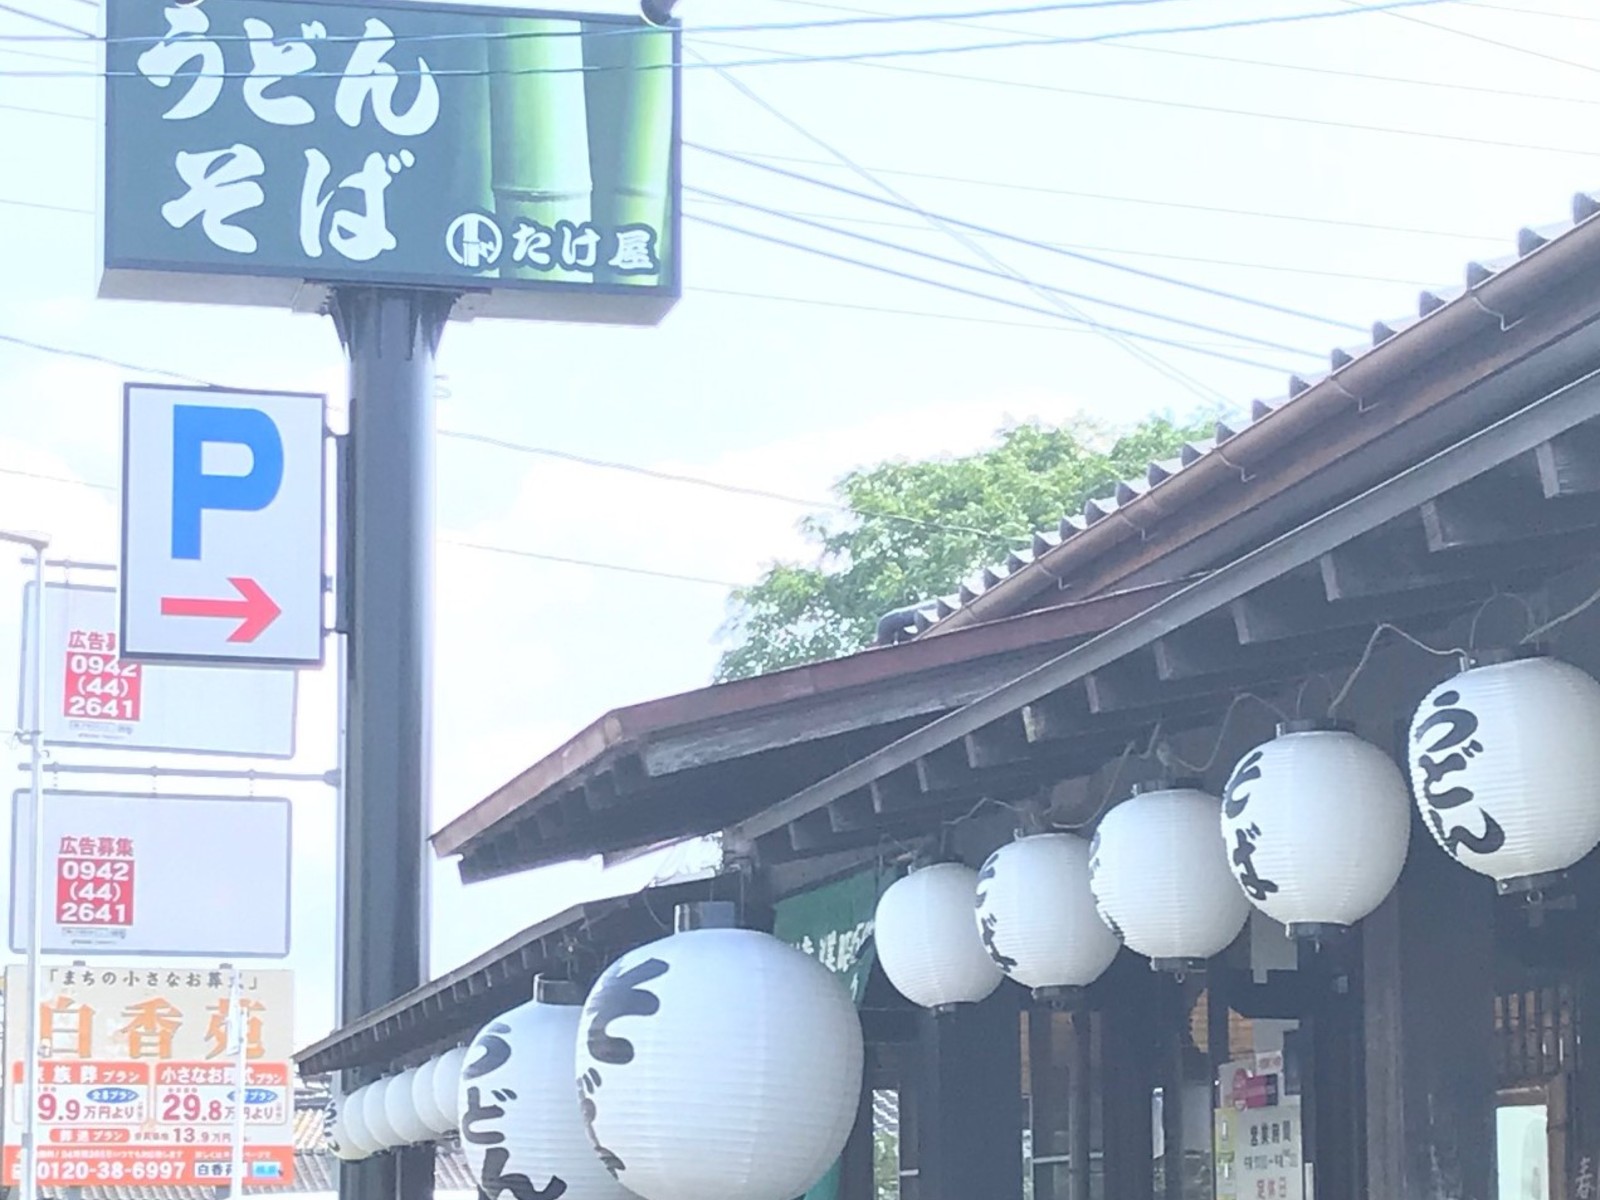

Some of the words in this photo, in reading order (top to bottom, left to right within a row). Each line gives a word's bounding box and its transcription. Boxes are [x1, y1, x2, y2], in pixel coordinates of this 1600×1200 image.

[137, 5, 441, 137] うどん
[161, 142, 416, 262] そば
[511, 222, 658, 270] たけ屋
[171, 404, 283, 560] P
[71, 655, 139, 679] 0942
[77, 676, 129, 698] (44)
[68, 696, 135, 719] 2641
[1415, 690, 1506, 857] うどん
[58, 836, 134, 858] 広告募集
[61, 861, 130, 882] 0942
[69, 881, 122, 903] (44)
[60, 902, 127, 923] 2641
[461, 1021, 568, 1200] うどん
[37, 1161, 187, 1180] 0120-38-6997
